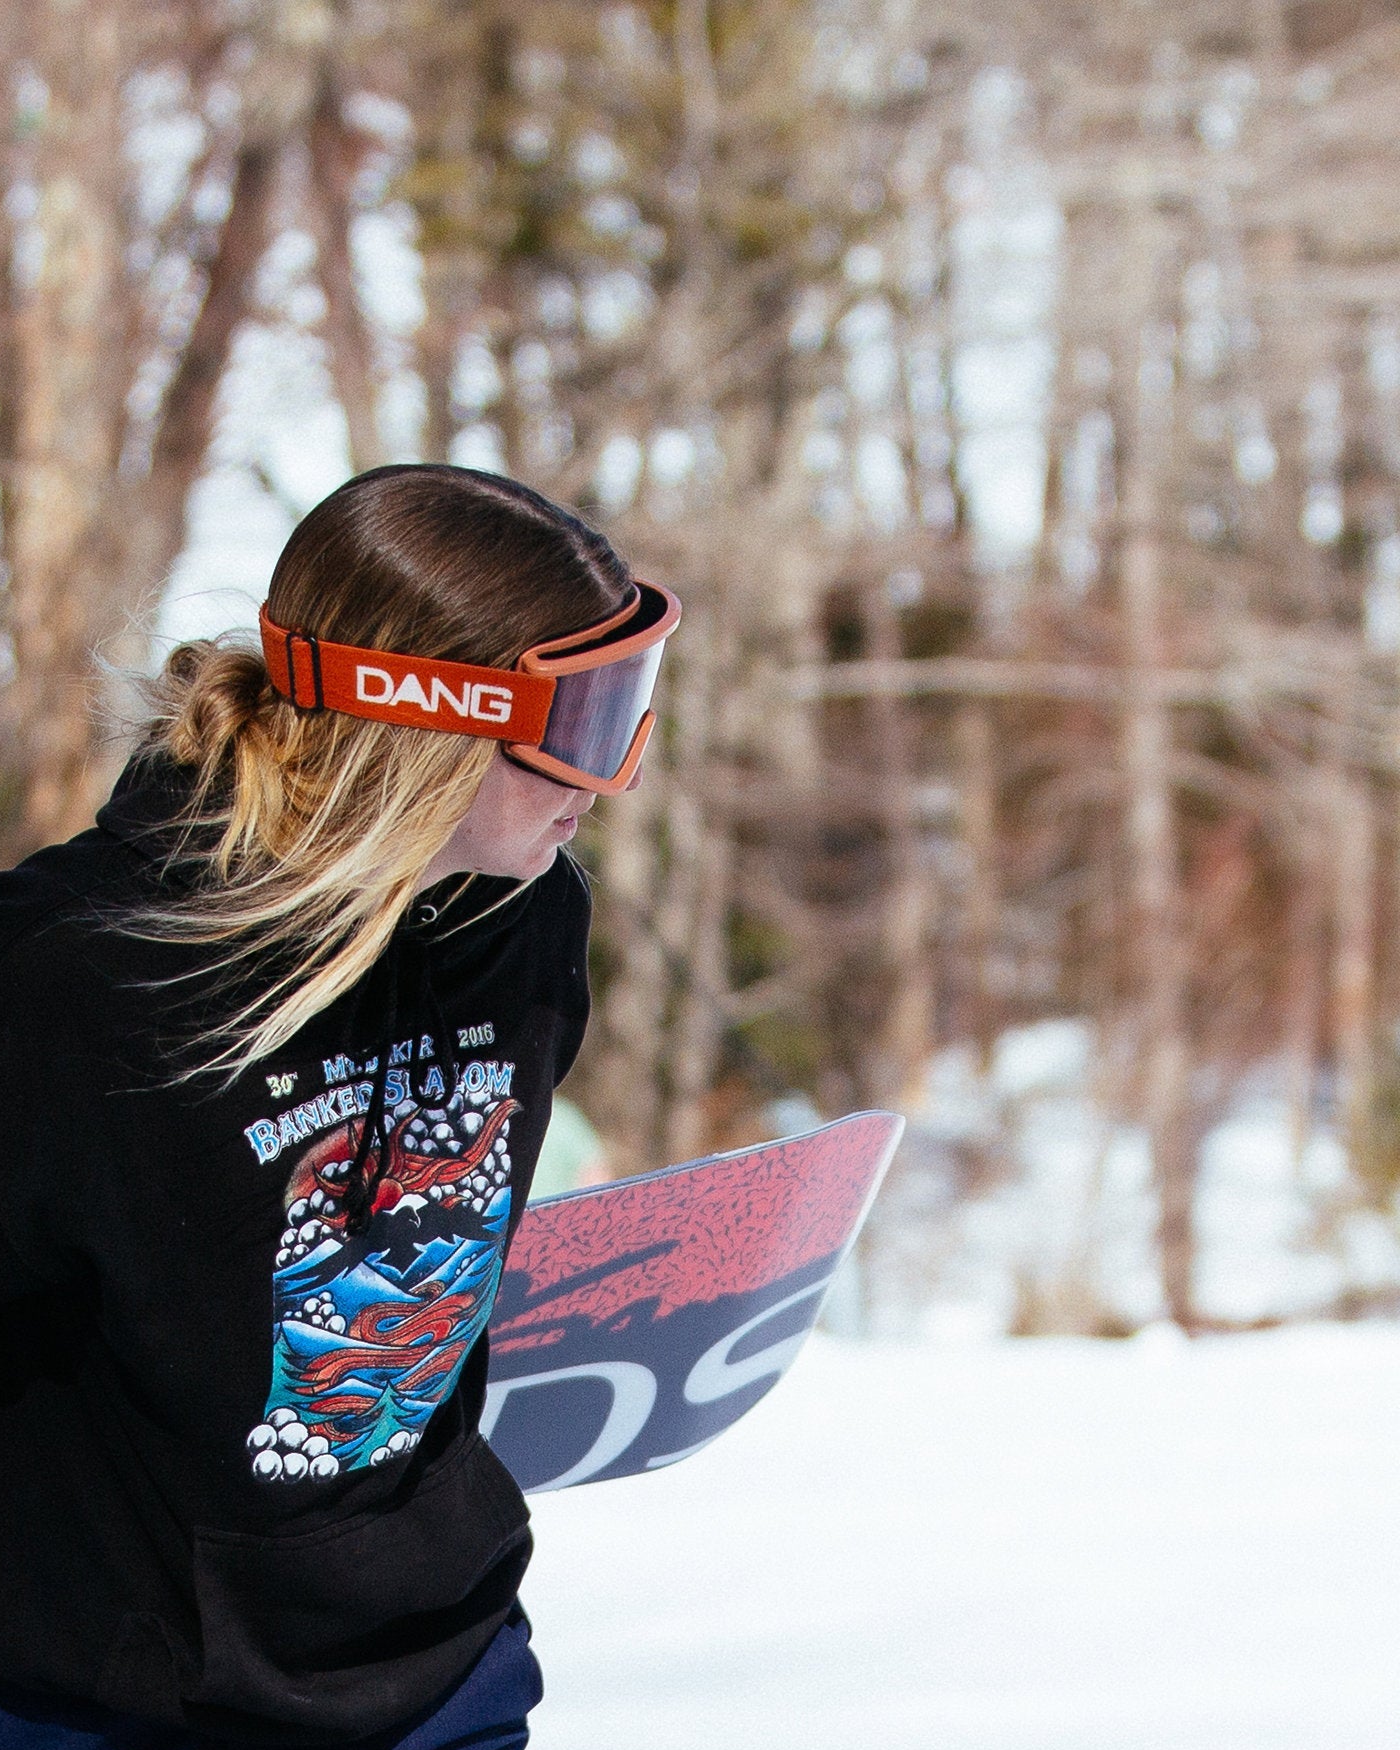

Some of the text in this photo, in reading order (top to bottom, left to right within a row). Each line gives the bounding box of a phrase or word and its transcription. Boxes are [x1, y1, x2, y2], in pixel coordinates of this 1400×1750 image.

[356, 665, 513, 725] DANG
[457, 1021, 495, 1048] 2016
[244, 1080, 375, 1165] BANKED
